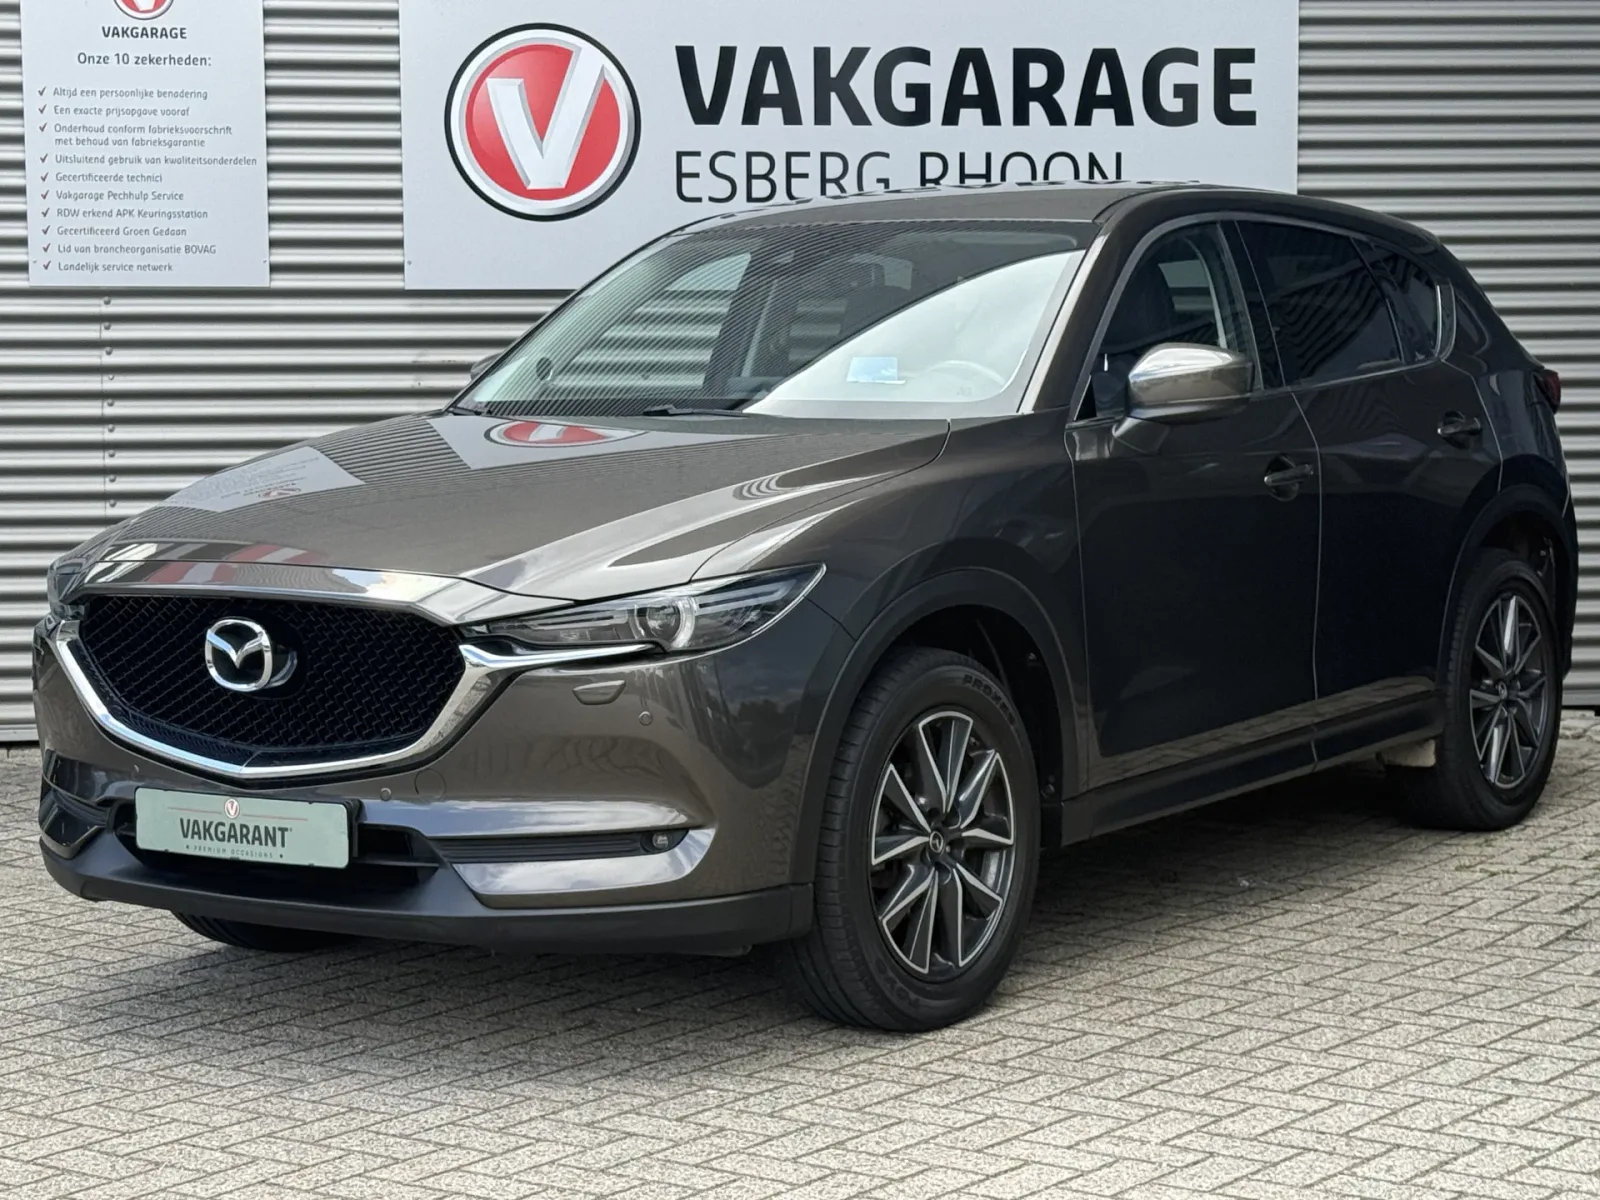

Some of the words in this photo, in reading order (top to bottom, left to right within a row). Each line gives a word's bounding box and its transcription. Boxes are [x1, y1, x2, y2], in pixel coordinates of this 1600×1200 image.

[102, 26, 186, 39] VAKGARAGE
[78, 52, 109, 64] Onze
[115, 53, 129, 64] 10
[135, 54, 211, 66] zekerheden:
[675, 45, 1257, 127] VAKGARAGE
[53, 88, 78, 99] Altijd
[80, 89, 97, 98] een
[100, 89, 155, 100] persoonlijke
[157, 90, 208, 101] benadering
[54, 105, 71, 115] Een
[74, 107, 103, 116] exacte
[106, 108, 158, 118] prijsopgave
[160, 108, 190, 117] vooraf
[54, 123, 105, 134] Onderhoud
[108, 125, 146, 134] conform
[149, 125, 233, 135] fabrieksvoorschrift
[55, 137, 74, 146] met
[76, 137, 110, 147] behoud
[112, 138, 129, 147] van
[132, 138, 206, 149] fabrieksgarantie
[56, 155, 106, 164] Uitsluitend
[108, 156, 143, 166] gebruik
[145, 157, 162, 165] van
[165, 156, 257, 166] kwaliteitsonderdelen
[56, 172, 124, 183] Gecertificeerde
[127, 174, 163, 183] technici
[676, 150, 890, 204] ESBERG
[919, 150, 1123, 186] RHOON
[56, 191, 105, 202] Vakgarage
[108, 191, 149, 201] Pechhulp
[152, 191, 184, 201] Service
[57, 208, 81, 218] RDW
[83, 209, 114, 218] erkend
[116, 209, 135, 218] APK
[138, 210, 209, 221] Keuringsstation
[57, 226, 121, 236] Gecertificeerd
[123, 227, 150, 237] Groen
[153, 227, 187, 237] Gedaan
[58, 244, 72, 254] Lid
[74, 245, 91, 254] van
[94, 245, 182, 256] brancheorganisatie
[185, 245, 217, 255] BOVAG
[59, 262, 100, 273] Landelijk
[102, 263, 134, 272] service
[137, 263, 173, 272] netwerk
[179, 817, 288, 848] VAKGARANT
[192, 844, 227, 855] PREMIUM
[230, 849, 273, 859] OCCASIONS
